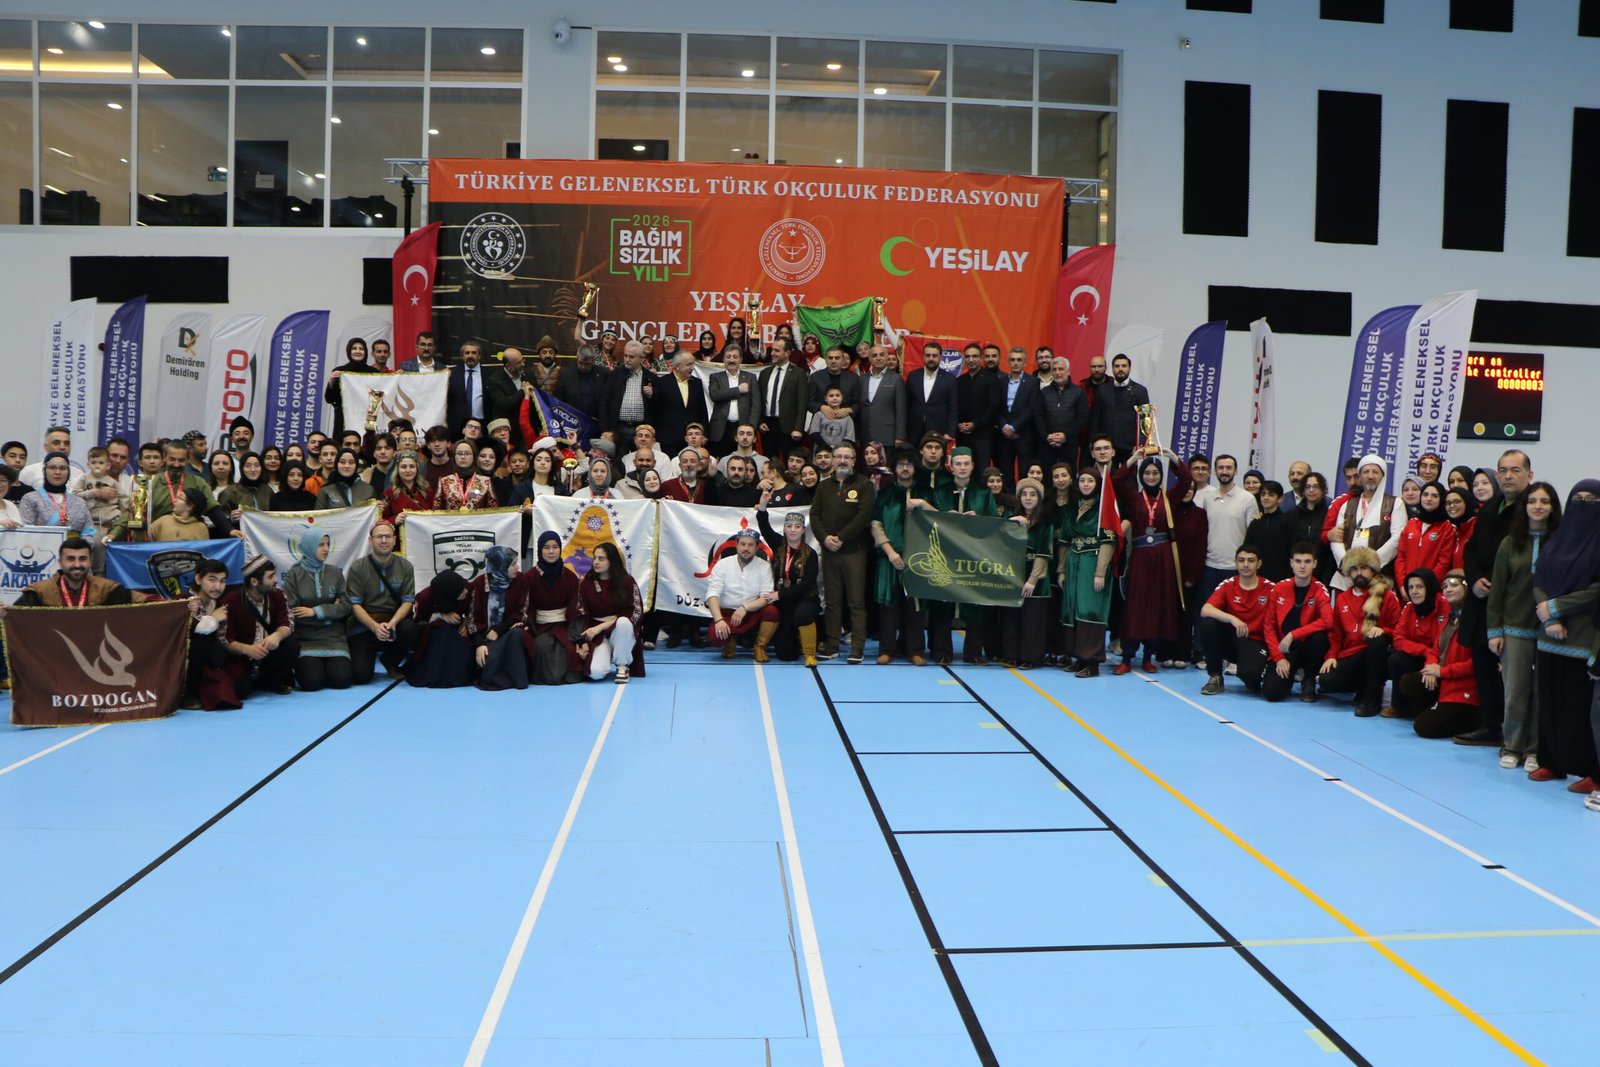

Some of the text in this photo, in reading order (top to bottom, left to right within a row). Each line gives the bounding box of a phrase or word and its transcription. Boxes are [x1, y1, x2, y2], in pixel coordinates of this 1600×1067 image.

[455, 171, 1040, 208] TÜRKİYE GELENEKSEL TÜRK OKÇULUK FEDERASYONU
[620, 227, 682, 247] BAĞIM
[633, 214, 670, 227] 2026
[619, 247, 682, 265] SIZLIK
[632, 265, 669, 282] YILI
[689, 287, 806, 317] YEŞİLAY
[51, 321, 62, 399] GELENEKSEL
[64, 341, 74, 398] OKÇULUK
[77, 344, 87, 431] FEDERASYONU
[127, 342, 138, 431] FEDERASYONU
[165, 354, 205, 368] Demirören
[170, 367, 199, 380] Holding
[278, 329, 293, 407] GELENEKSEL
[1181, 343, 1197, 421] GELENEKSEL
[1357, 328, 1380, 421] GELENEKSEL
[1374, 352, 1394, 422] OKÇULUK
[1413, 319, 1431, 418] GELENEKSEL
[1430, 345, 1446, 419] OKÇULUK
[1484, 367, 1542, 379] controller
[1490, 357, 1502, 366] on
[288, 349, 305, 444] TÜRK OKÇULUK
[1192, 363, 1205, 423] OKÇULUK
[955, 558, 1016, 577] TUĞRA
